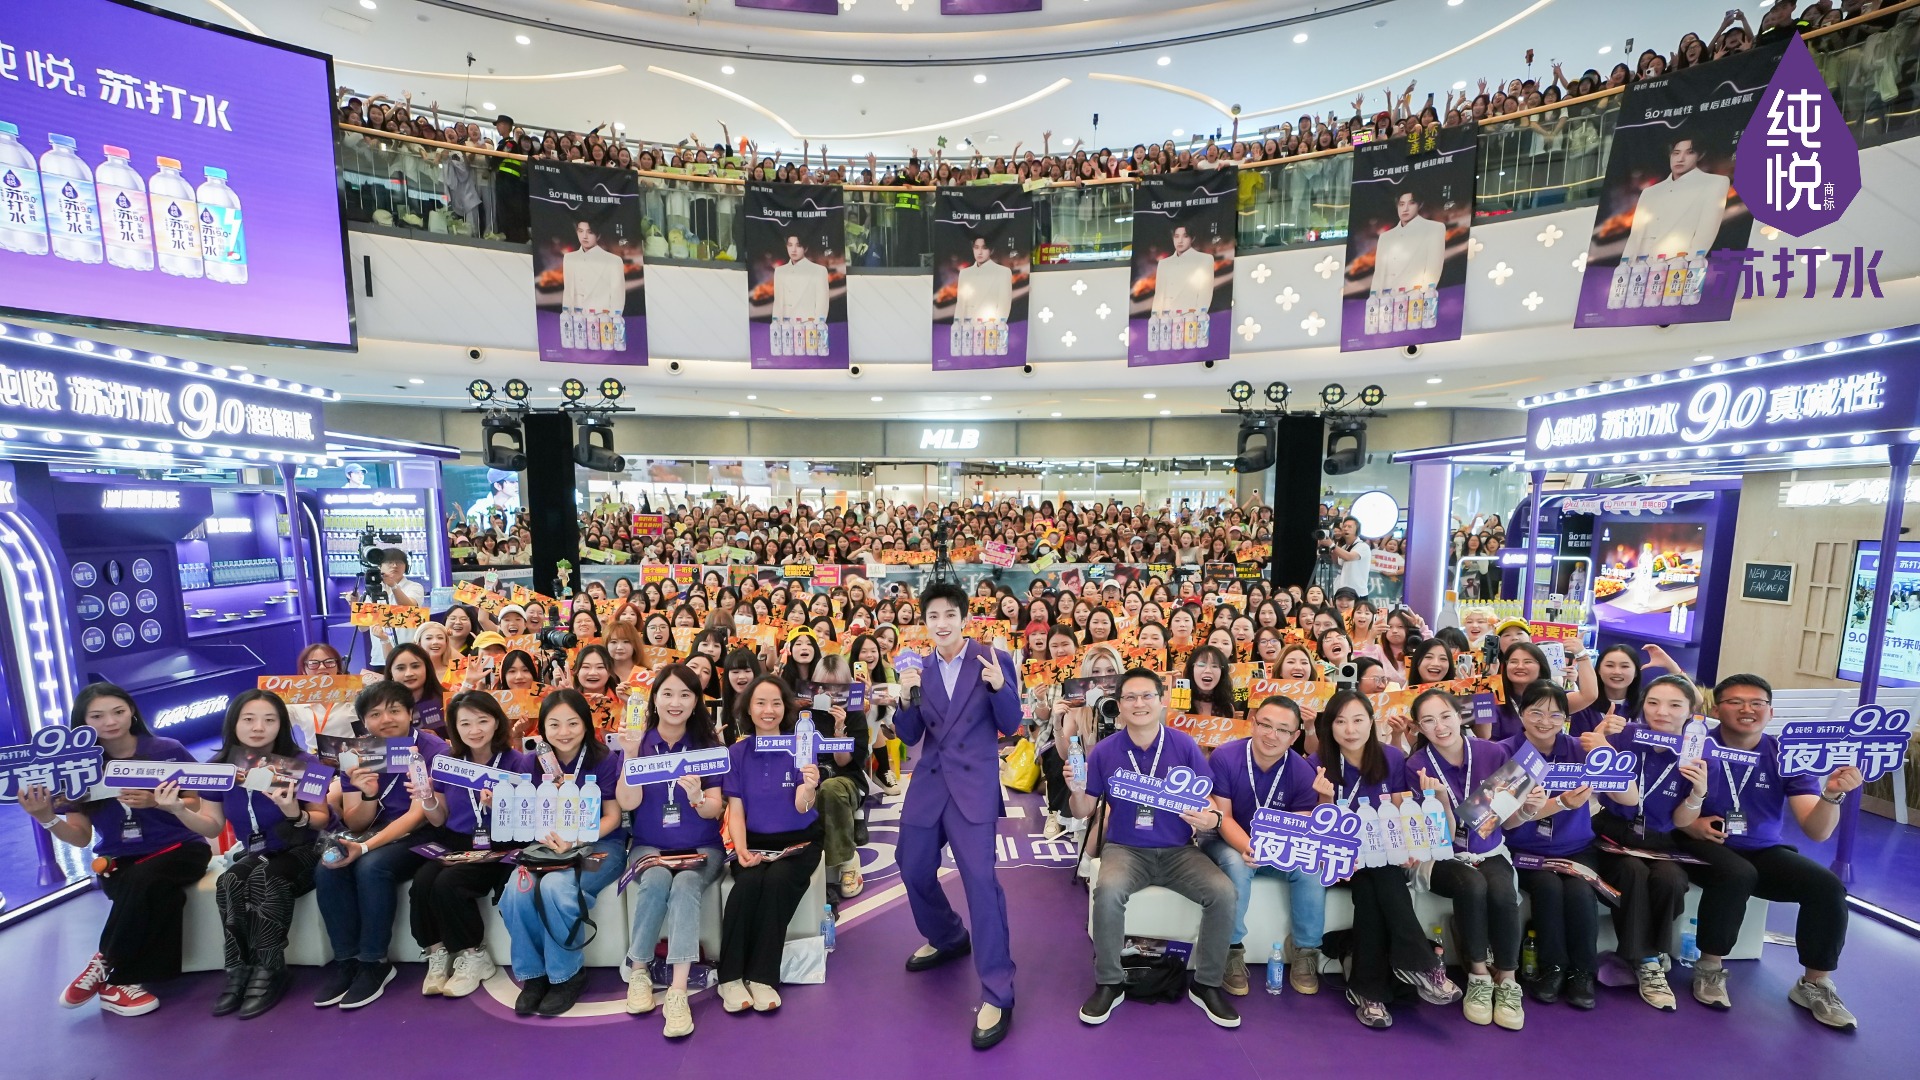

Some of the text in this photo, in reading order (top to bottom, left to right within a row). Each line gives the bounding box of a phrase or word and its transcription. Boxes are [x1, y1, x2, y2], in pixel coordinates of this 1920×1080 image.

[97, 69, 233, 131] 苏打水
[66, 375, 175, 426] 苏打水
[1600, 402, 1679, 441] 苏打水
[1766, 371, 1887, 423] 真碱性
[919, 429, 980, 450] MLB
[1749, 567, 1768, 580] NEW
[1750, 581, 1785, 594] FARMER
[266, 675, 334, 690] OneSD
[1255, 679, 1316, 695] OneSD
[1173, 713, 1234, 731] OneSD
[1794, 707, 1906, 736] 纯悦 苏打水 9.0
[35, 728, 92, 758] 9.0
[818, 742, 853, 750] 餐后超解腻
[683, 760, 726, 774] 餐后超解腻
[1558, 750, 1632, 775] 苏打水 9.0
[1712, 749, 1758, 765] 餐后超解腻
[1784, 742, 1902, 780] 夜宵节
[0, 757, 98, 798] 宵节
[178, 776, 228, 786] 餐后超解腻
[1122, 768, 1209, 796] 纯悦 苏打水 9.0
[1264, 807, 1358, 835] 纯悦 苏打水 9.0
[1254, 830, 1354, 883] 夜宵节
